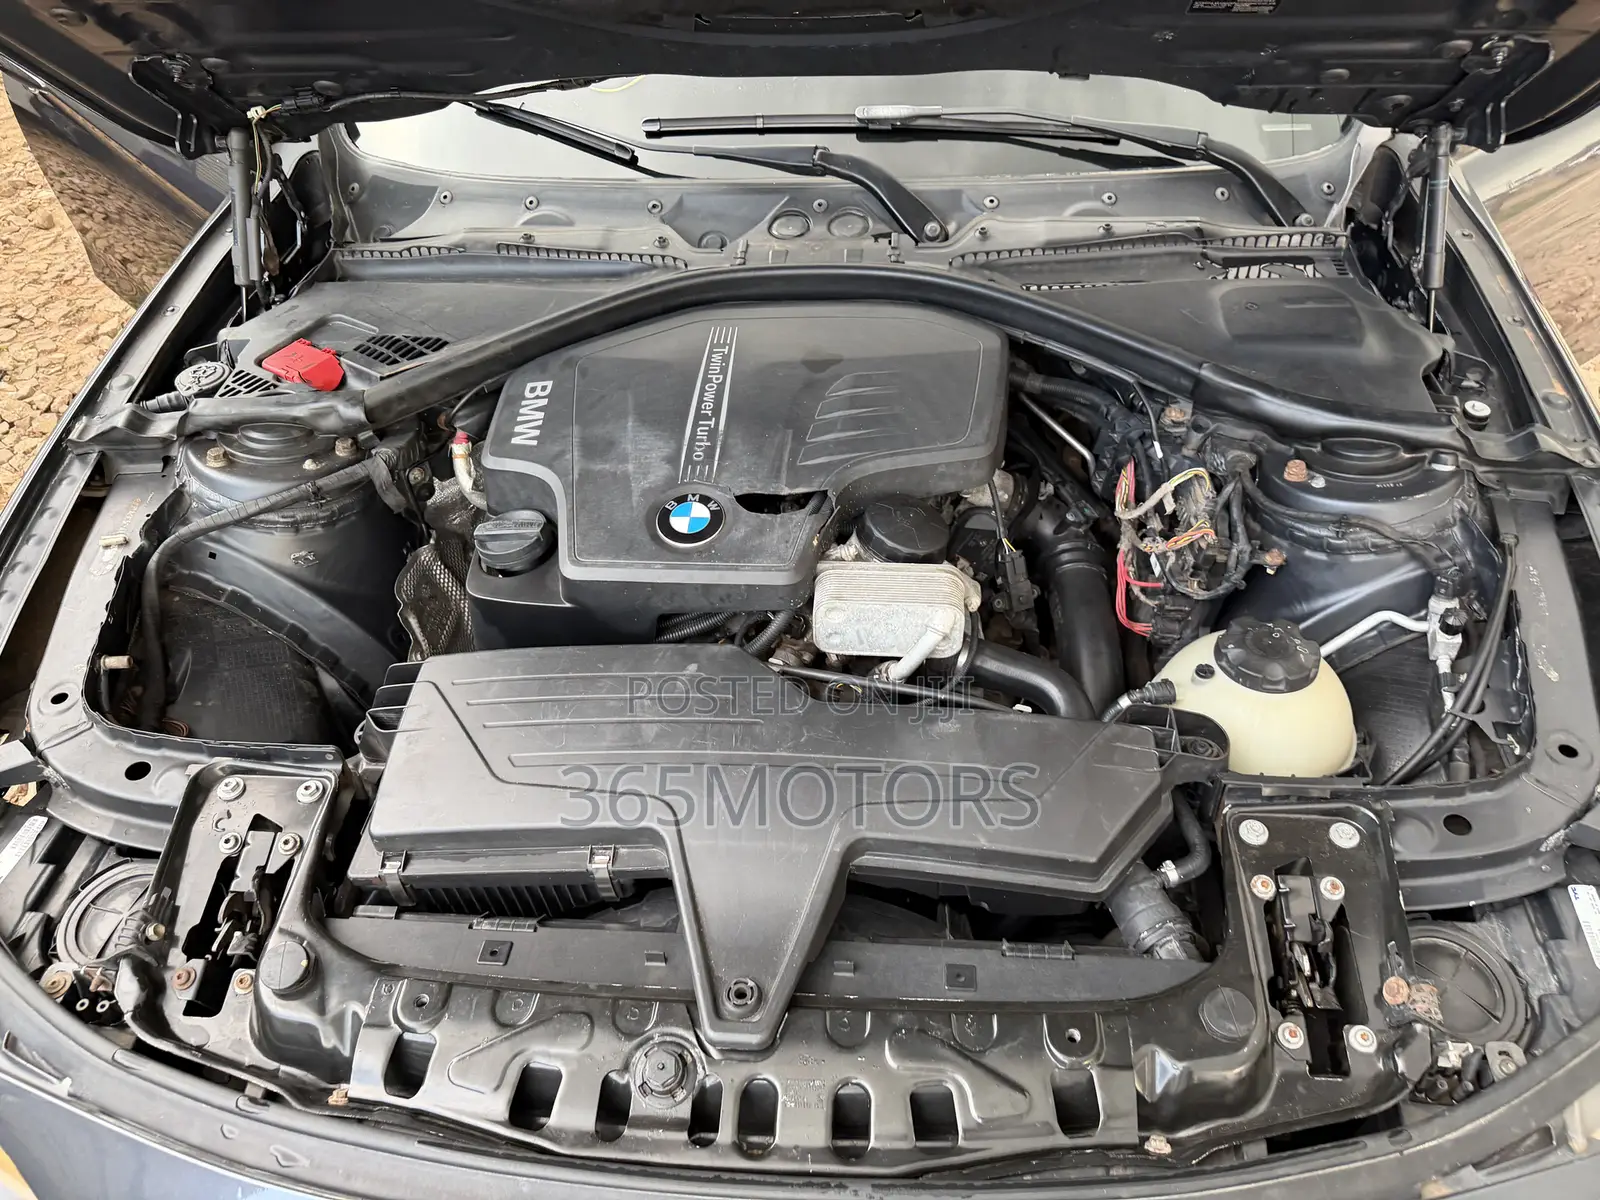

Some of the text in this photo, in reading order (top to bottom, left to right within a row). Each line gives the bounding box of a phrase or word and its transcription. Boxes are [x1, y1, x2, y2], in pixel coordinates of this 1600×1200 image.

[510, 380, 554, 446] BMW
[692, 345, 729, 461] TwinPower Turbo
[664, 494, 721, 511] BMW
